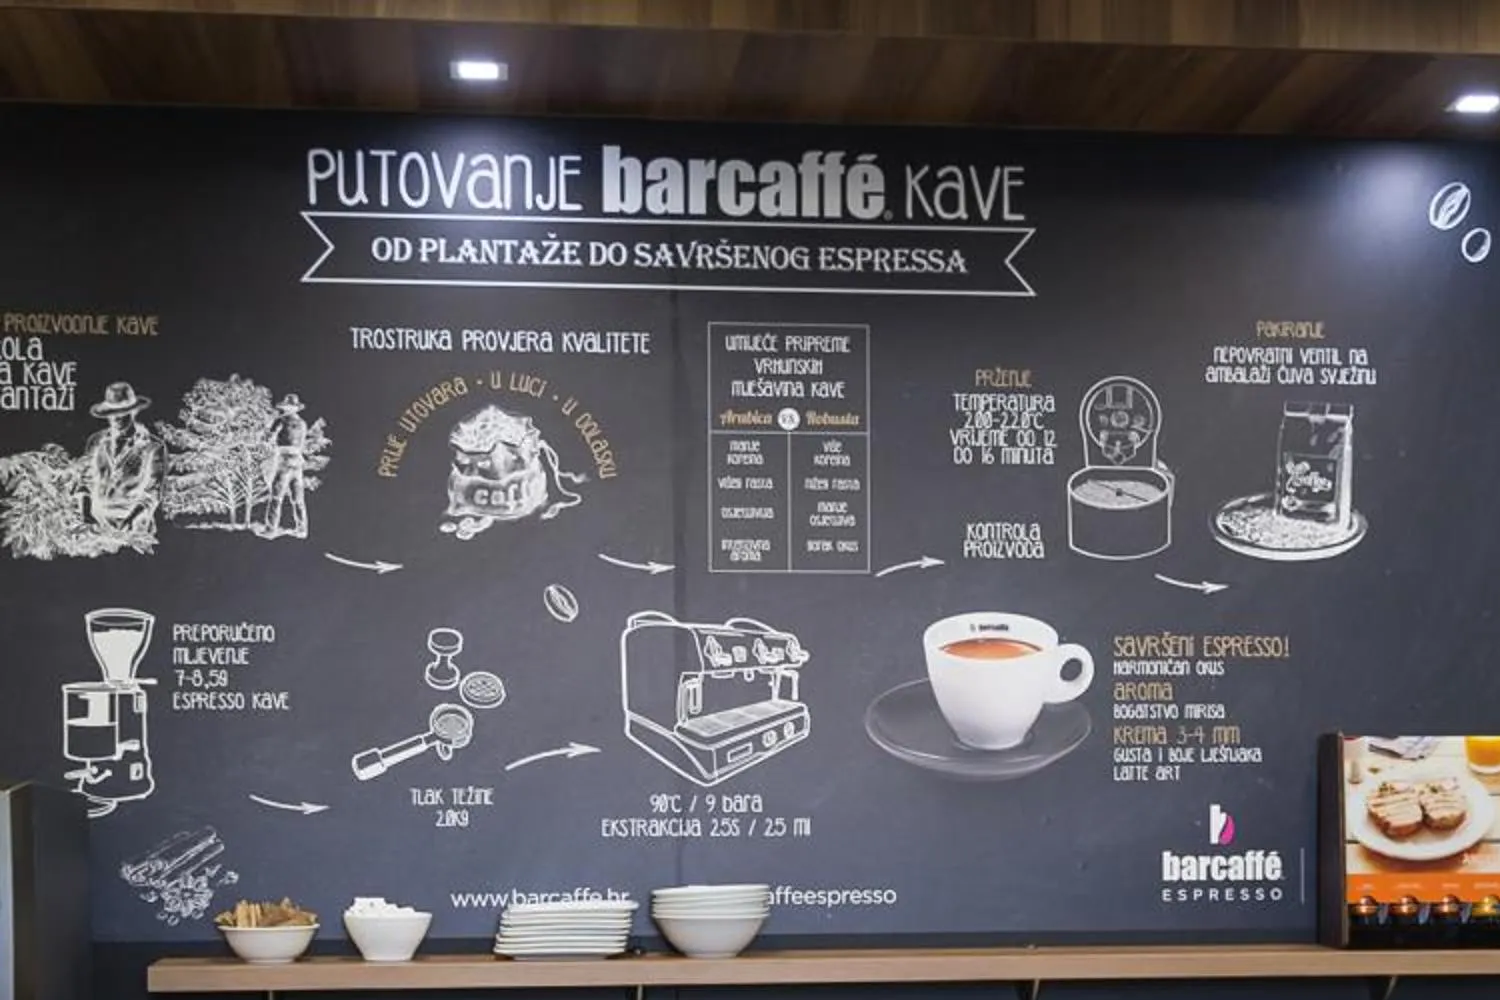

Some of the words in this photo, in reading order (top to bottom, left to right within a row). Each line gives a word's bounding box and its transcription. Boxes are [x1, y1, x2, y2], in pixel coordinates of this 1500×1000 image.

[602, 145, 887, 220] barcaffé
[371, 236, 411, 262] OD
[418, 233, 583, 266] PLANTAŽE
[588, 242, 627, 267] DO
[633, 239, 810, 271] SAVRŠENOG
[818, 247, 968, 274] ESPRESSA
[490, 370, 502, 389] U
[981, 447, 995, 465] 16
[1203, 635, 1290, 657] ESPRESSO!
[173, 691, 245, 710] ESPRESSO
[705, 794, 716, 813] 9
[764, 818, 788, 837] 25
[1162, 851, 1283, 882] barcaffé
[450, 887, 630, 908] wwwbarcaffehr
[1162, 887, 1284, 901] ESPRESSO
